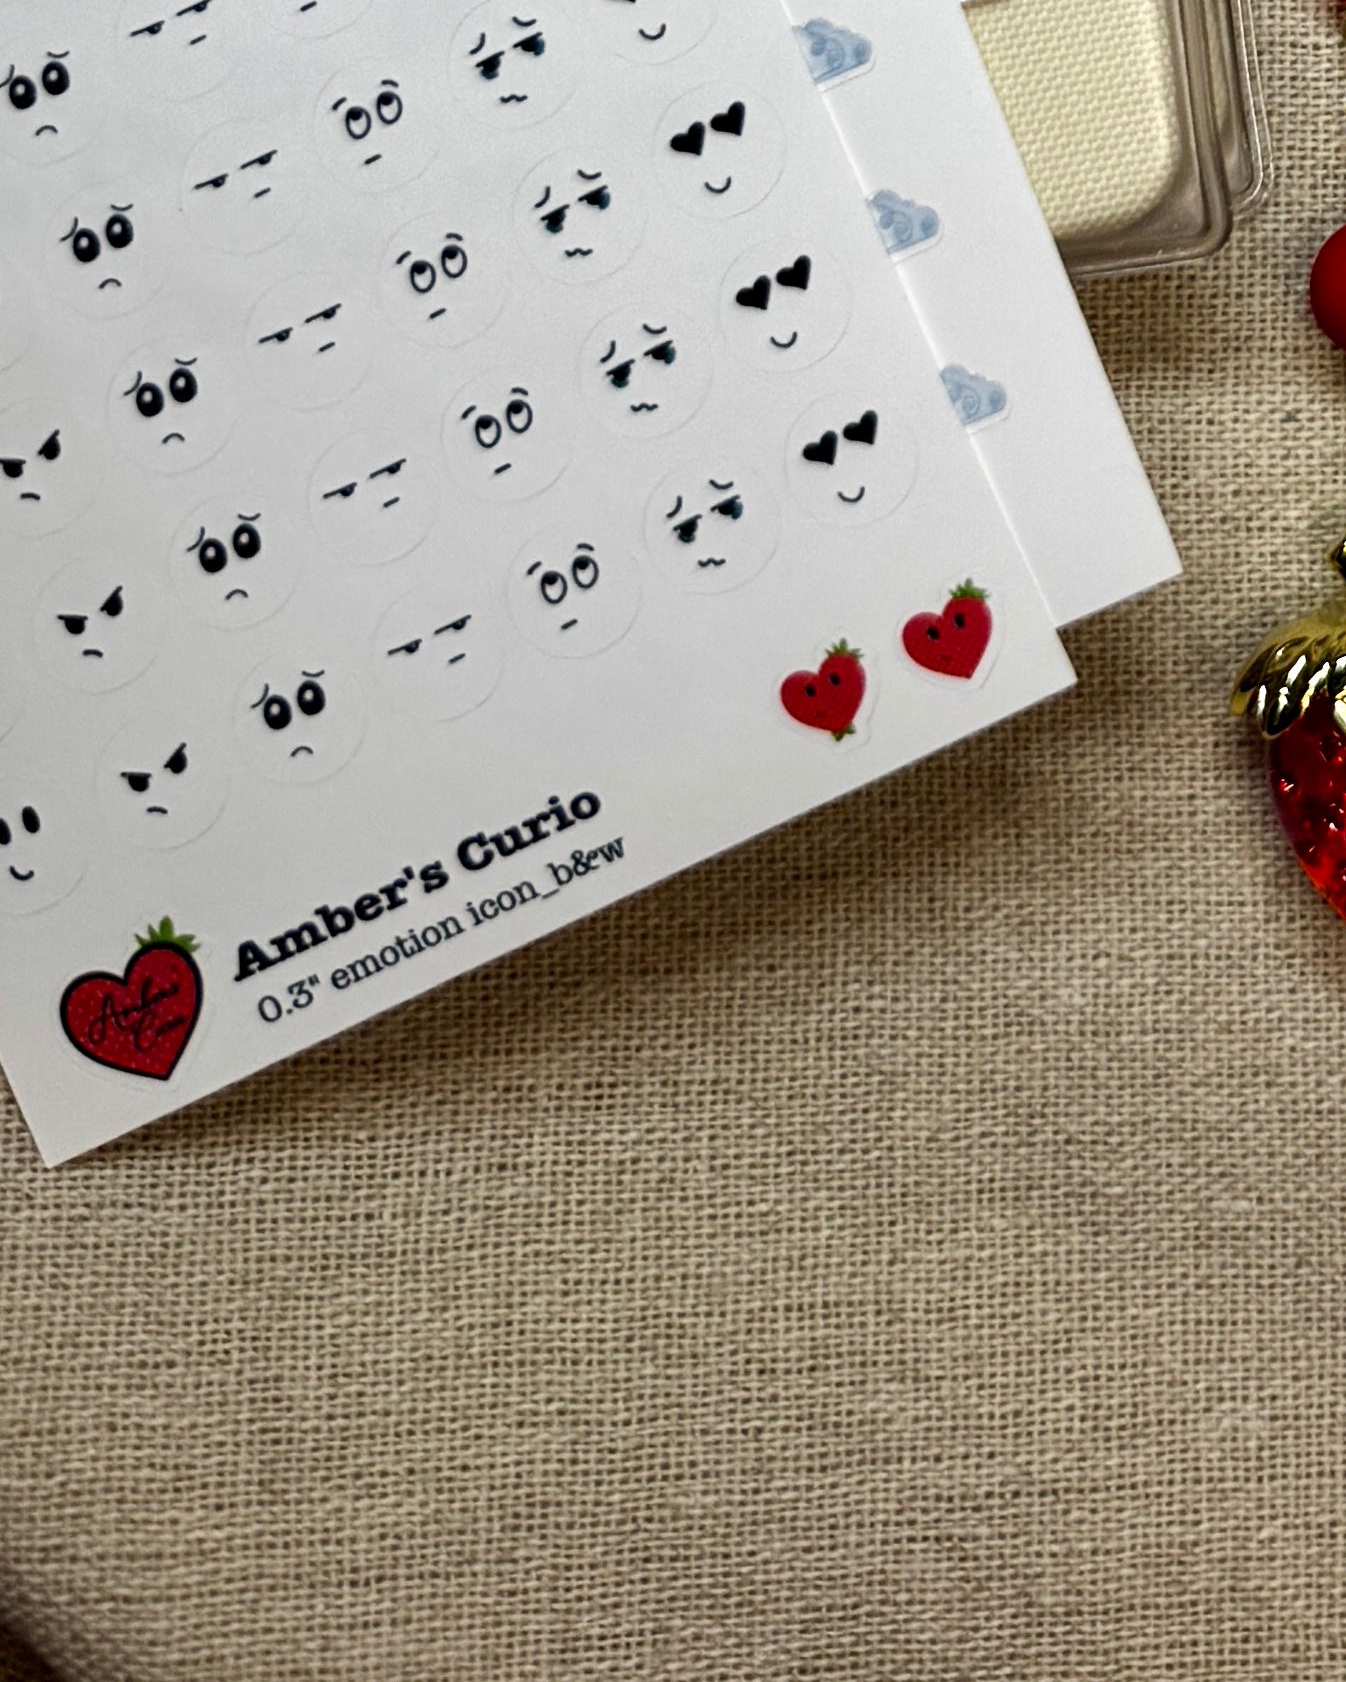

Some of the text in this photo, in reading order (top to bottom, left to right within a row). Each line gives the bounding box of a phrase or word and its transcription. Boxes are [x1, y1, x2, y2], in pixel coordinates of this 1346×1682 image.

[232, 789, 602, 982] Amber's Curio
[256, 835, 627, 1025] 0.3" emotion icon_b&w
